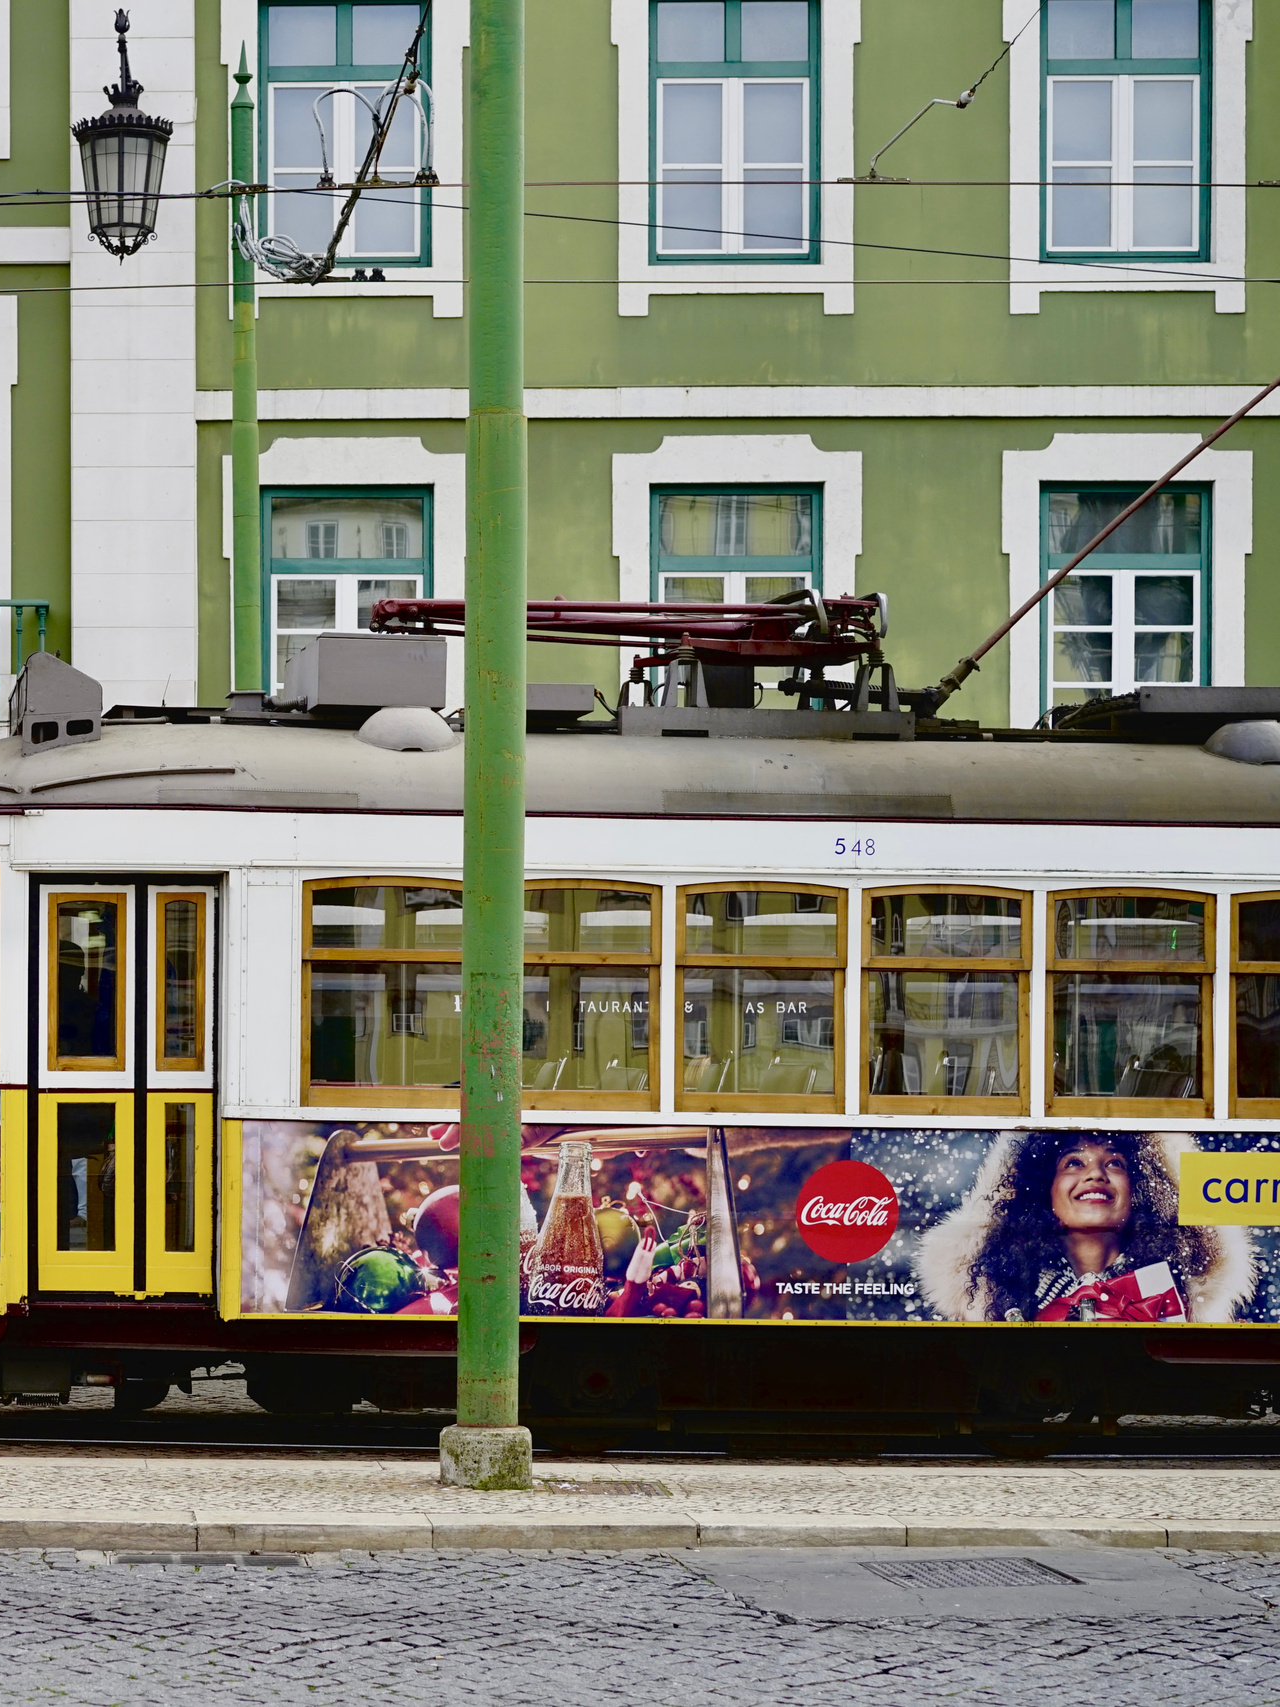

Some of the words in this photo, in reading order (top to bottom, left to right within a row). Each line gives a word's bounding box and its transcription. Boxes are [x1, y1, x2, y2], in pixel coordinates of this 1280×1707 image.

[835, 838, 875, 856] 548
[776, 1001, 807, 1013] BAR
[800, 1195, 895, 1227] Coca-Cola
[563, 1265, 599, 1274] ORIGINAL
[776, 1282, 820, 1294] TASTE
[823, 1283, 852, 1294] THE
[855, 1283, 915, 1295] FEELING
